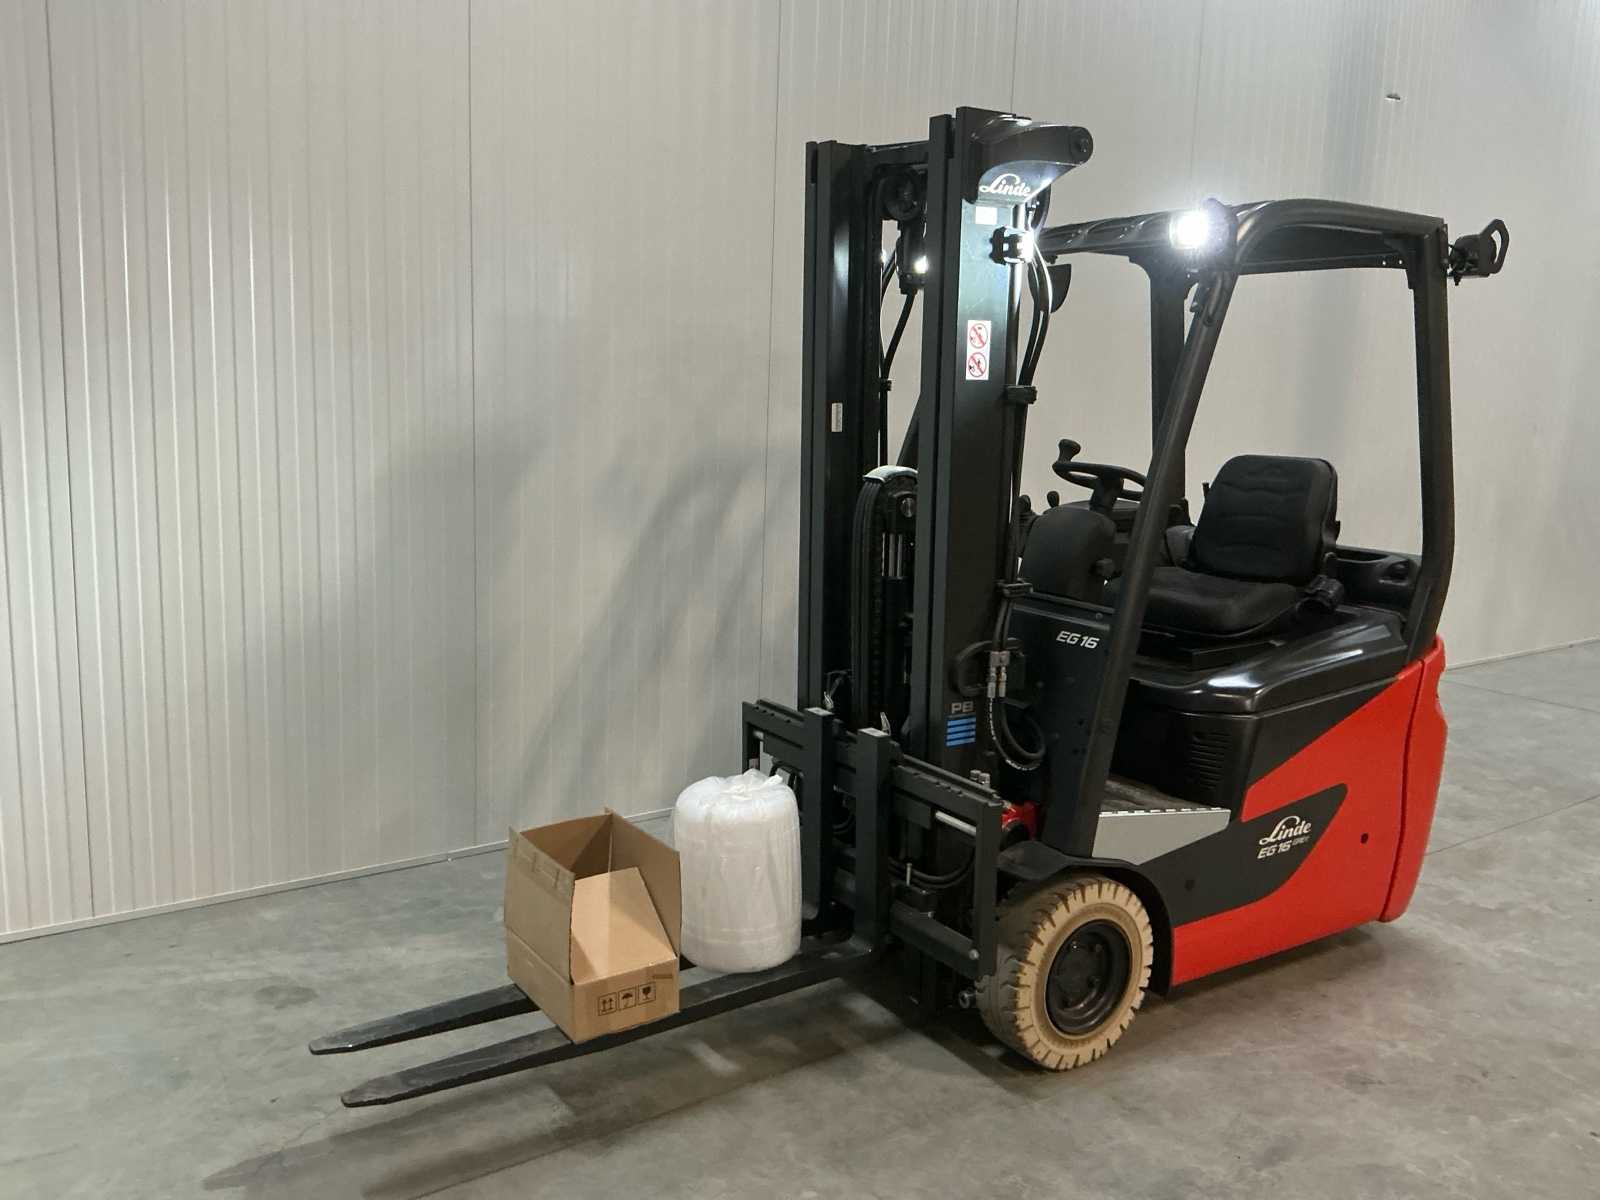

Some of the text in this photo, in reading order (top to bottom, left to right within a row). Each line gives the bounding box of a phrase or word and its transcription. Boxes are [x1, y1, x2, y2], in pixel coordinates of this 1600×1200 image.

[979, 173, 1031, 197] Linde
[1056, 631, 1100, 649] EG 16
[1259, 816, 1311, 845] Linde
[1257, 844, 1278, 859] EG
[1277, 840, 1292, 853] 16
